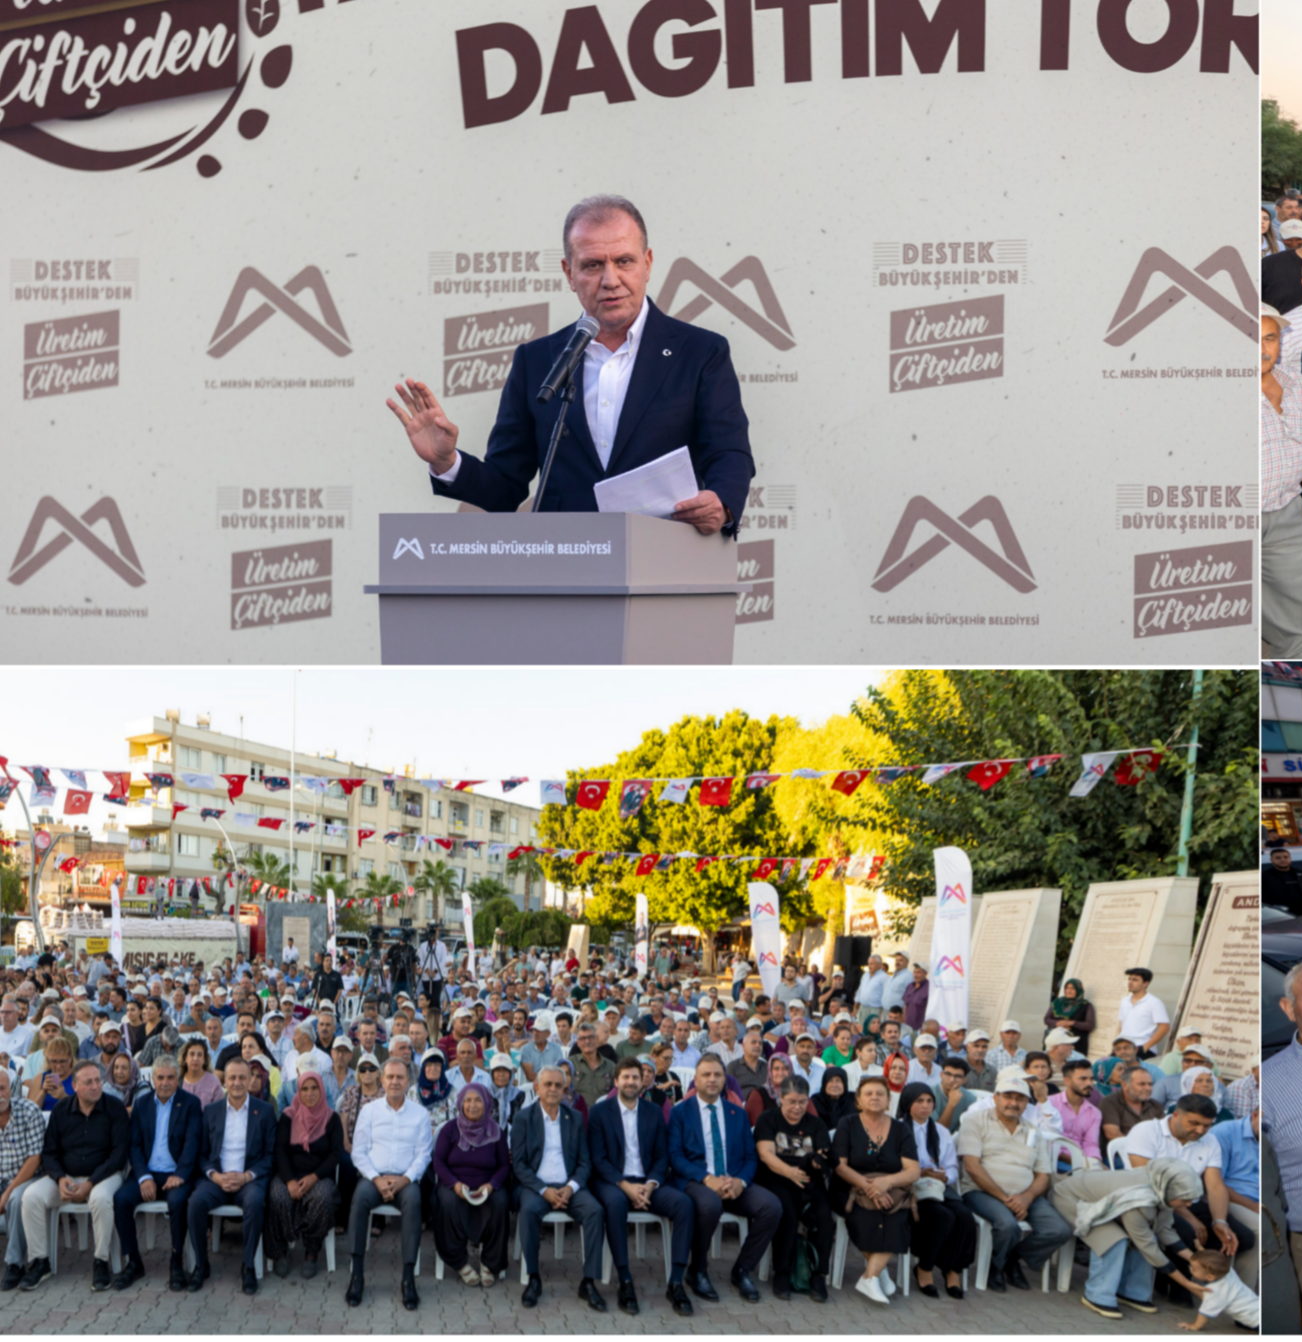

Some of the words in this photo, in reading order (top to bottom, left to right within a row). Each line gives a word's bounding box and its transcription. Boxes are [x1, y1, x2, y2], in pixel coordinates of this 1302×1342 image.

[456, 252, 541, 274] DESTEK
[902, 241, 995, 265] DESTEK
[34, 260, 112, 281] DESTEK
[878, 268, 1019, 290] BÜYÜKŞEHİR'DEN
[15, 285, 132, 305] BÜYÜKŞEHİR'DEN
[434, 277, 563, 298] BÜYÜKŞEHİR'DEN
[457, 317, 535, 351] Üretim
[904, 309, 989, 345] Üretim
[36, 322, 107, 355] Üretim
[26, 358, 118, 399] Çiftçiden
[749, 371, 798, 383] BELEDİYESİ
[893, 346, 1003, 391] Çiftçiden
[1101, 370, 1118, 379] T.C.
[1120, 367, 1158, 379] MERSİN
[1160, 366, 1223, 381] BÜYÜKŞEHİR
[220, 377, 251, 390] MERSİN
[254, 377, 307, 391] BÜYÜKŞEHİR
[309, 376, 355, 388] BELEDİYESİ
[242, 488, 324, 509] DESTEK
[1147, 485, 1242, 508] DESTEK
[221, 512, 345, 533] BÜYÜKŞEHİR'DEN
[430, 543, 447, 555] T.C.
[449, 540, 488, 555] MERSİN
[491, 540, 554, 558] BÜYÜKŞEHİR
[557, 540, 611, 555] BELEDİYESİ
[243, 552, 319, 585] Üretim
[1150, 553, 1237, 589] Üretim
[20, 605, 50, 616] MERSİN
[52, 604, 103, 618] BÜYÜKŞEHİR
[105, 606, 148, 618] BELEDİYESİ
[233, 588, 330, 629] Çiftçiden
[869, 615, 885, 625] T.C.
[887, 612, 923, 625] MERSİN
[926, 612, 986, 627] BÜYÜKŞEHİR
[989, 613, 1040, 626] BELEDİYESİ
[1138, 592, 1251, 636] Çiftçiden
